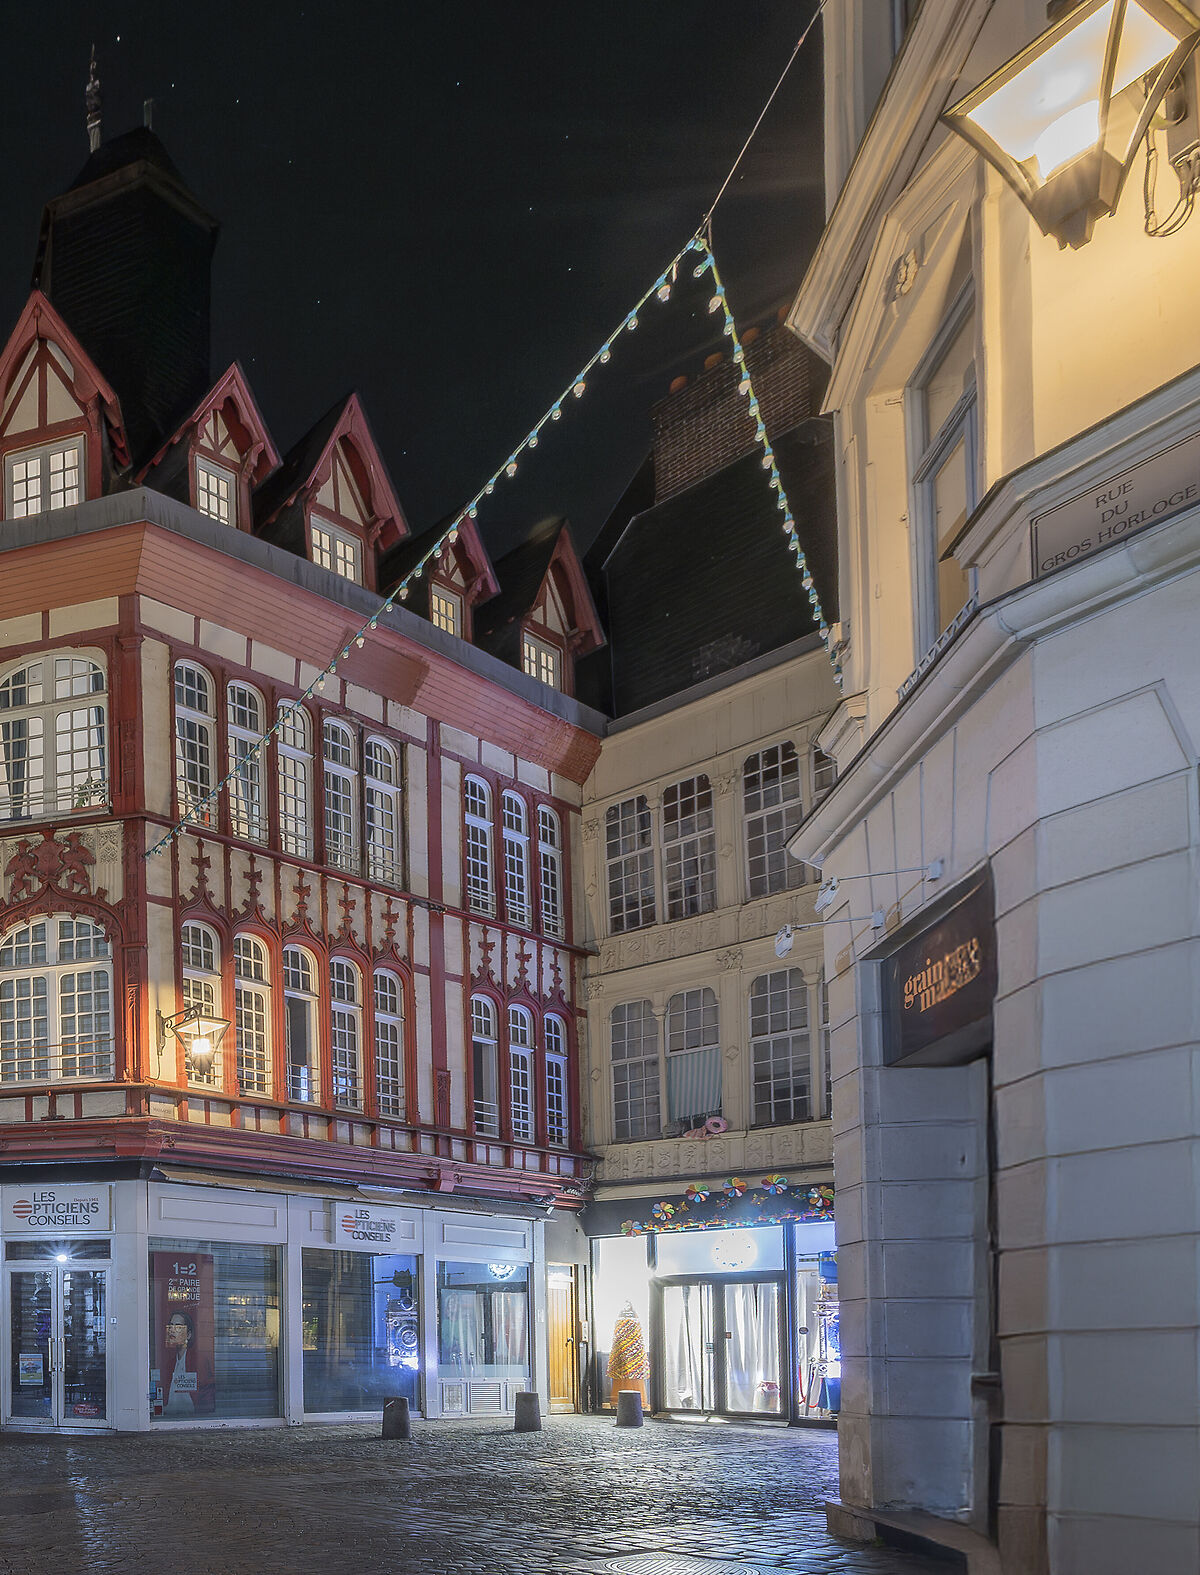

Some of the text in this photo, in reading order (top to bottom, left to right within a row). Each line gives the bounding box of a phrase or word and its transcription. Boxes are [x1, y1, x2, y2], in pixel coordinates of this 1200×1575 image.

[1095, 479, 1134, 509] RUE
[1101, 500, 1129, 524] DU
[1041, 484, 1198, 572] GROS HORLOGE
[33, 1192, 56, 1202] LES
[28, 1214, 90, 1226] CONSEILS
[355, 1209, 370, 1220] LES
[352, 1230, 392, 1243] CONSEILS
[172, 1261, 197, 1276] 1=2
[180, 1278, 200, 1287] PAIRE
